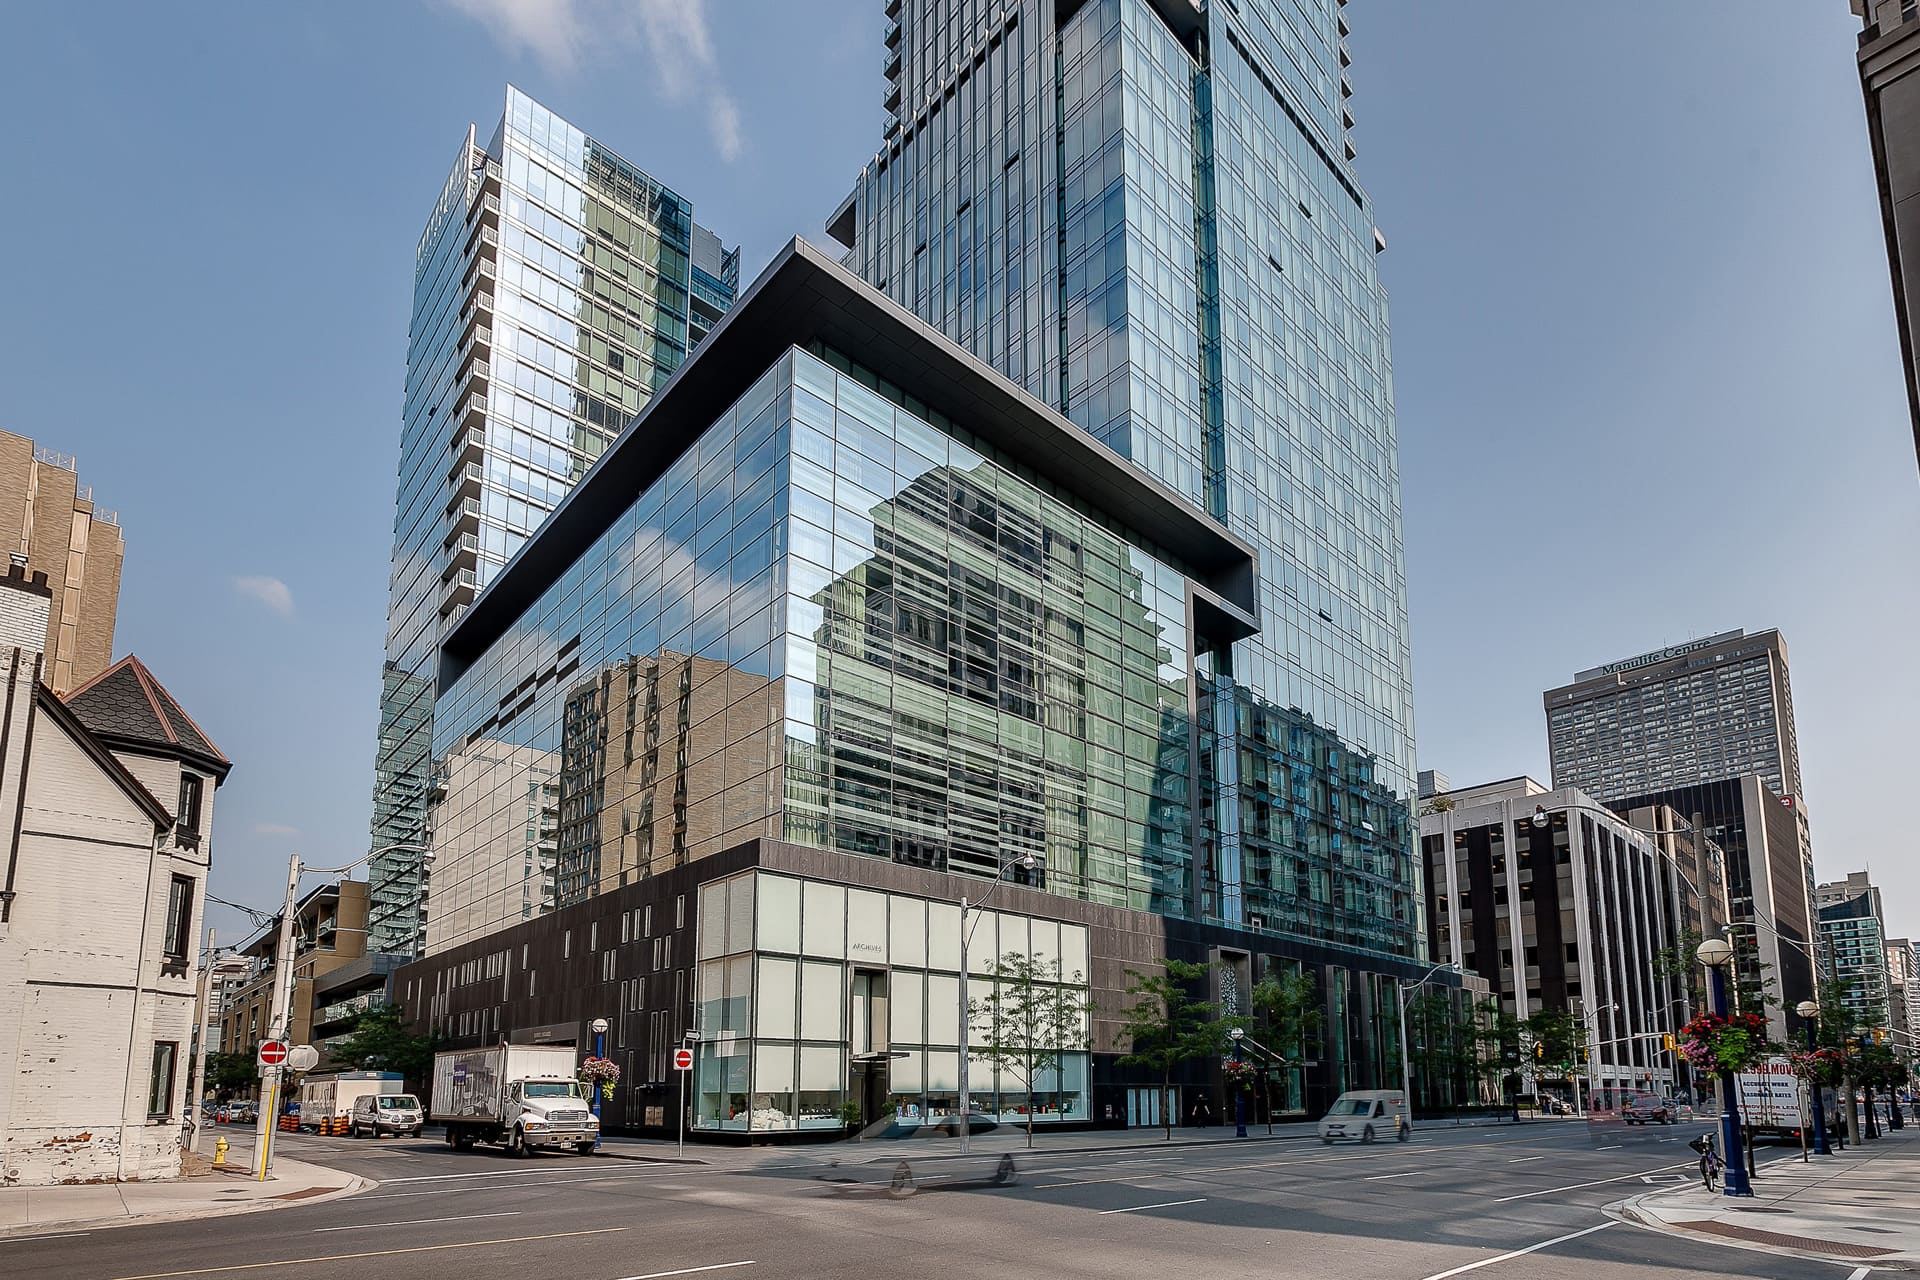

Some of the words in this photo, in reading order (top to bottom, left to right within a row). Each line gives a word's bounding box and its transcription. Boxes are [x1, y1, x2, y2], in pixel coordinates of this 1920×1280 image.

[1601, 653, 1660, 675] Manulife
[1663, 639, 1711, 659] Centre
[852, 943, 882, 953] ARCHIVES
